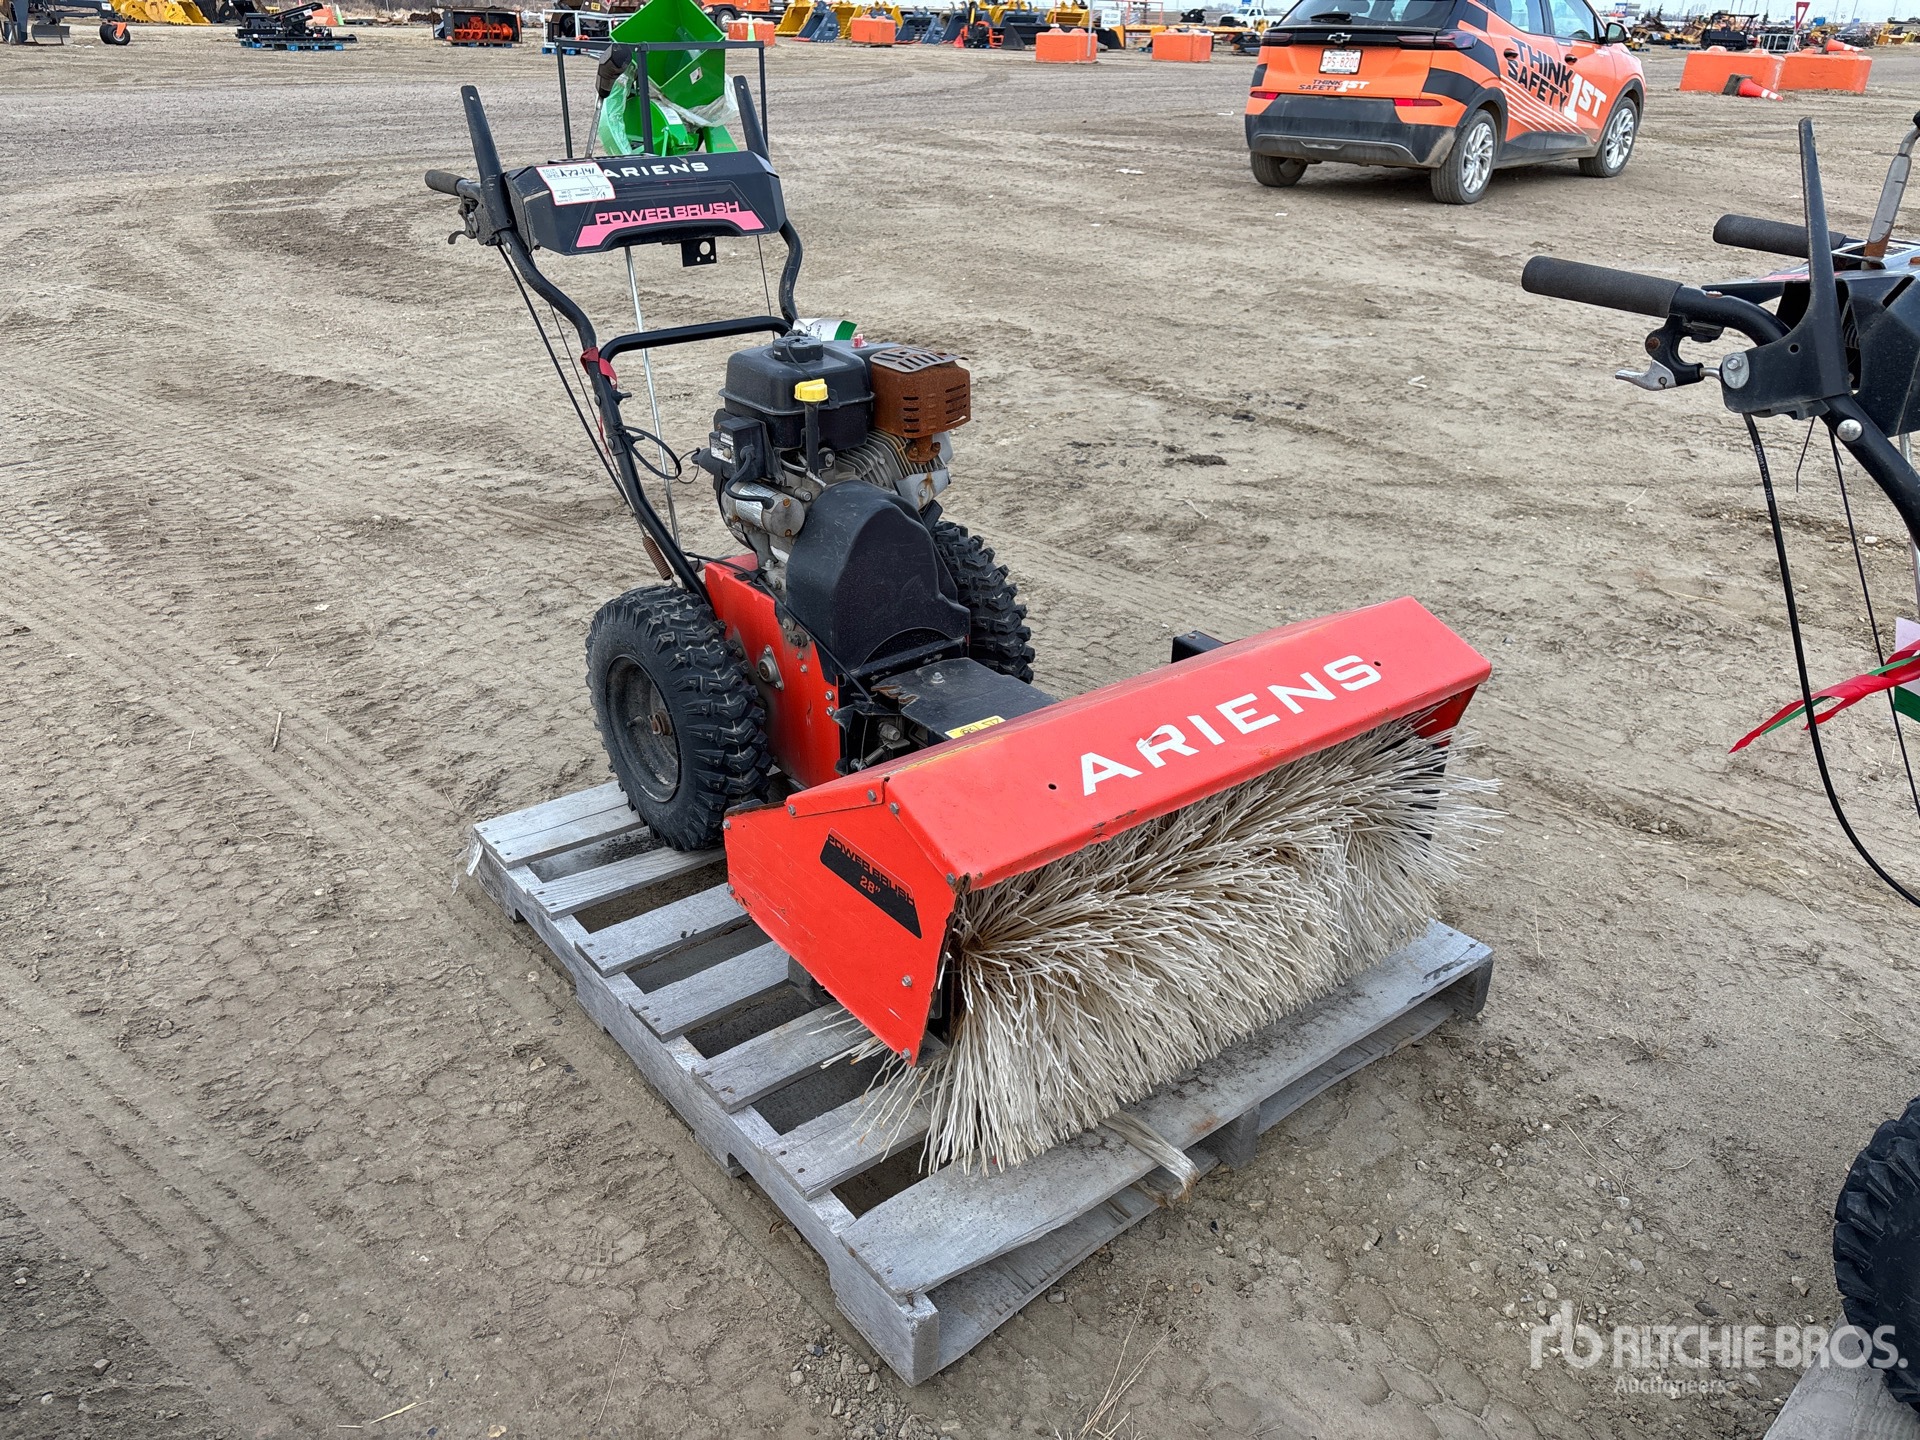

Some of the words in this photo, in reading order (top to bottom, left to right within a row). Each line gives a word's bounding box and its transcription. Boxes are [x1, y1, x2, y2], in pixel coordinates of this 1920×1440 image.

[1336, 79, 1370, 92] 1ST
[1507, 59, 1568, 112] SAFETY
[1510, 36, 1574, 93] THINK
[1563, 73, 1607, 122] 1ST
[602, 161, 709, 179] ARIENS
[595, 207, 670, 226] POWER
[674, 201, 740, 220] BRUSH
[1079, 653, 1383, 797] ARIENS
[827, 834, 872, 875] POWER
[871, 866, 916, 907] BRUSH
